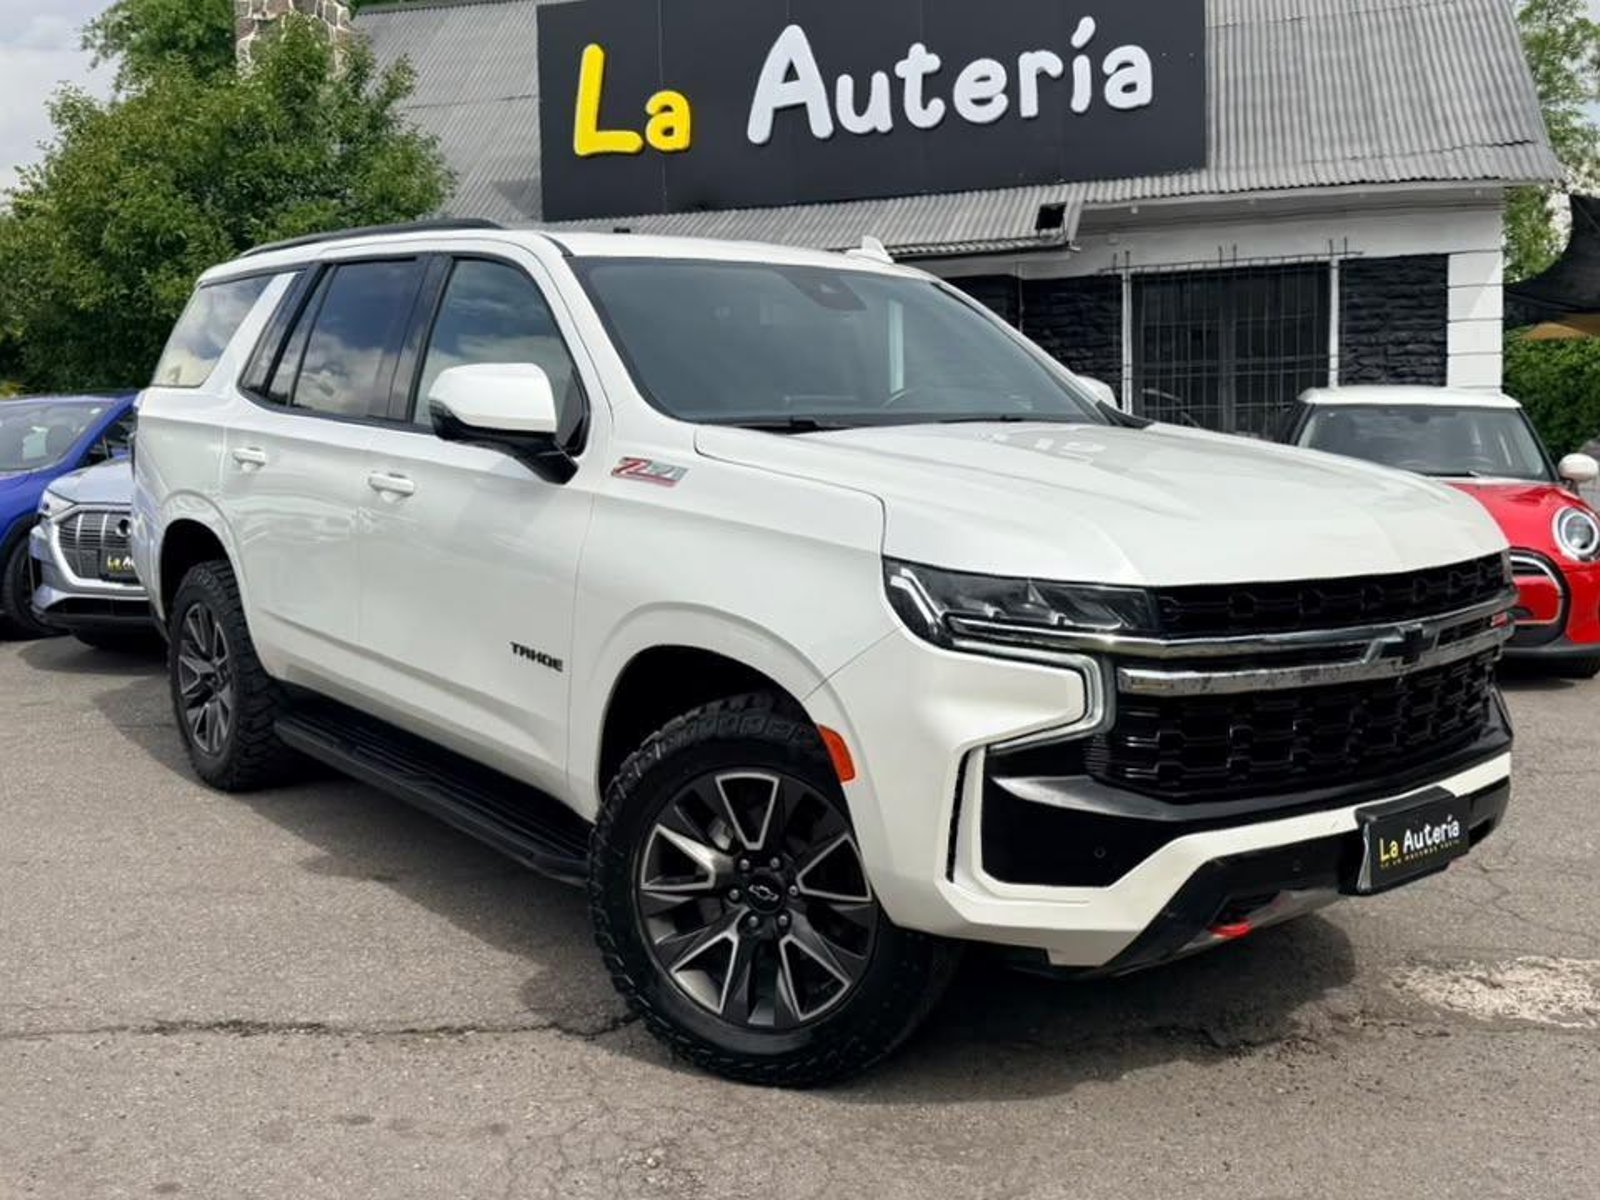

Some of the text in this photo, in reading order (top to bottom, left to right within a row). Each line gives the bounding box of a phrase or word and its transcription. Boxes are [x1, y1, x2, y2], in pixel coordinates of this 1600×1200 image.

[573, 16, 1154, 156] La Autería
[509, 641, 563, 672] TAHOE
[1379, 838, 1399, 862] La
[1403, 815, 1460, 853] Autería
